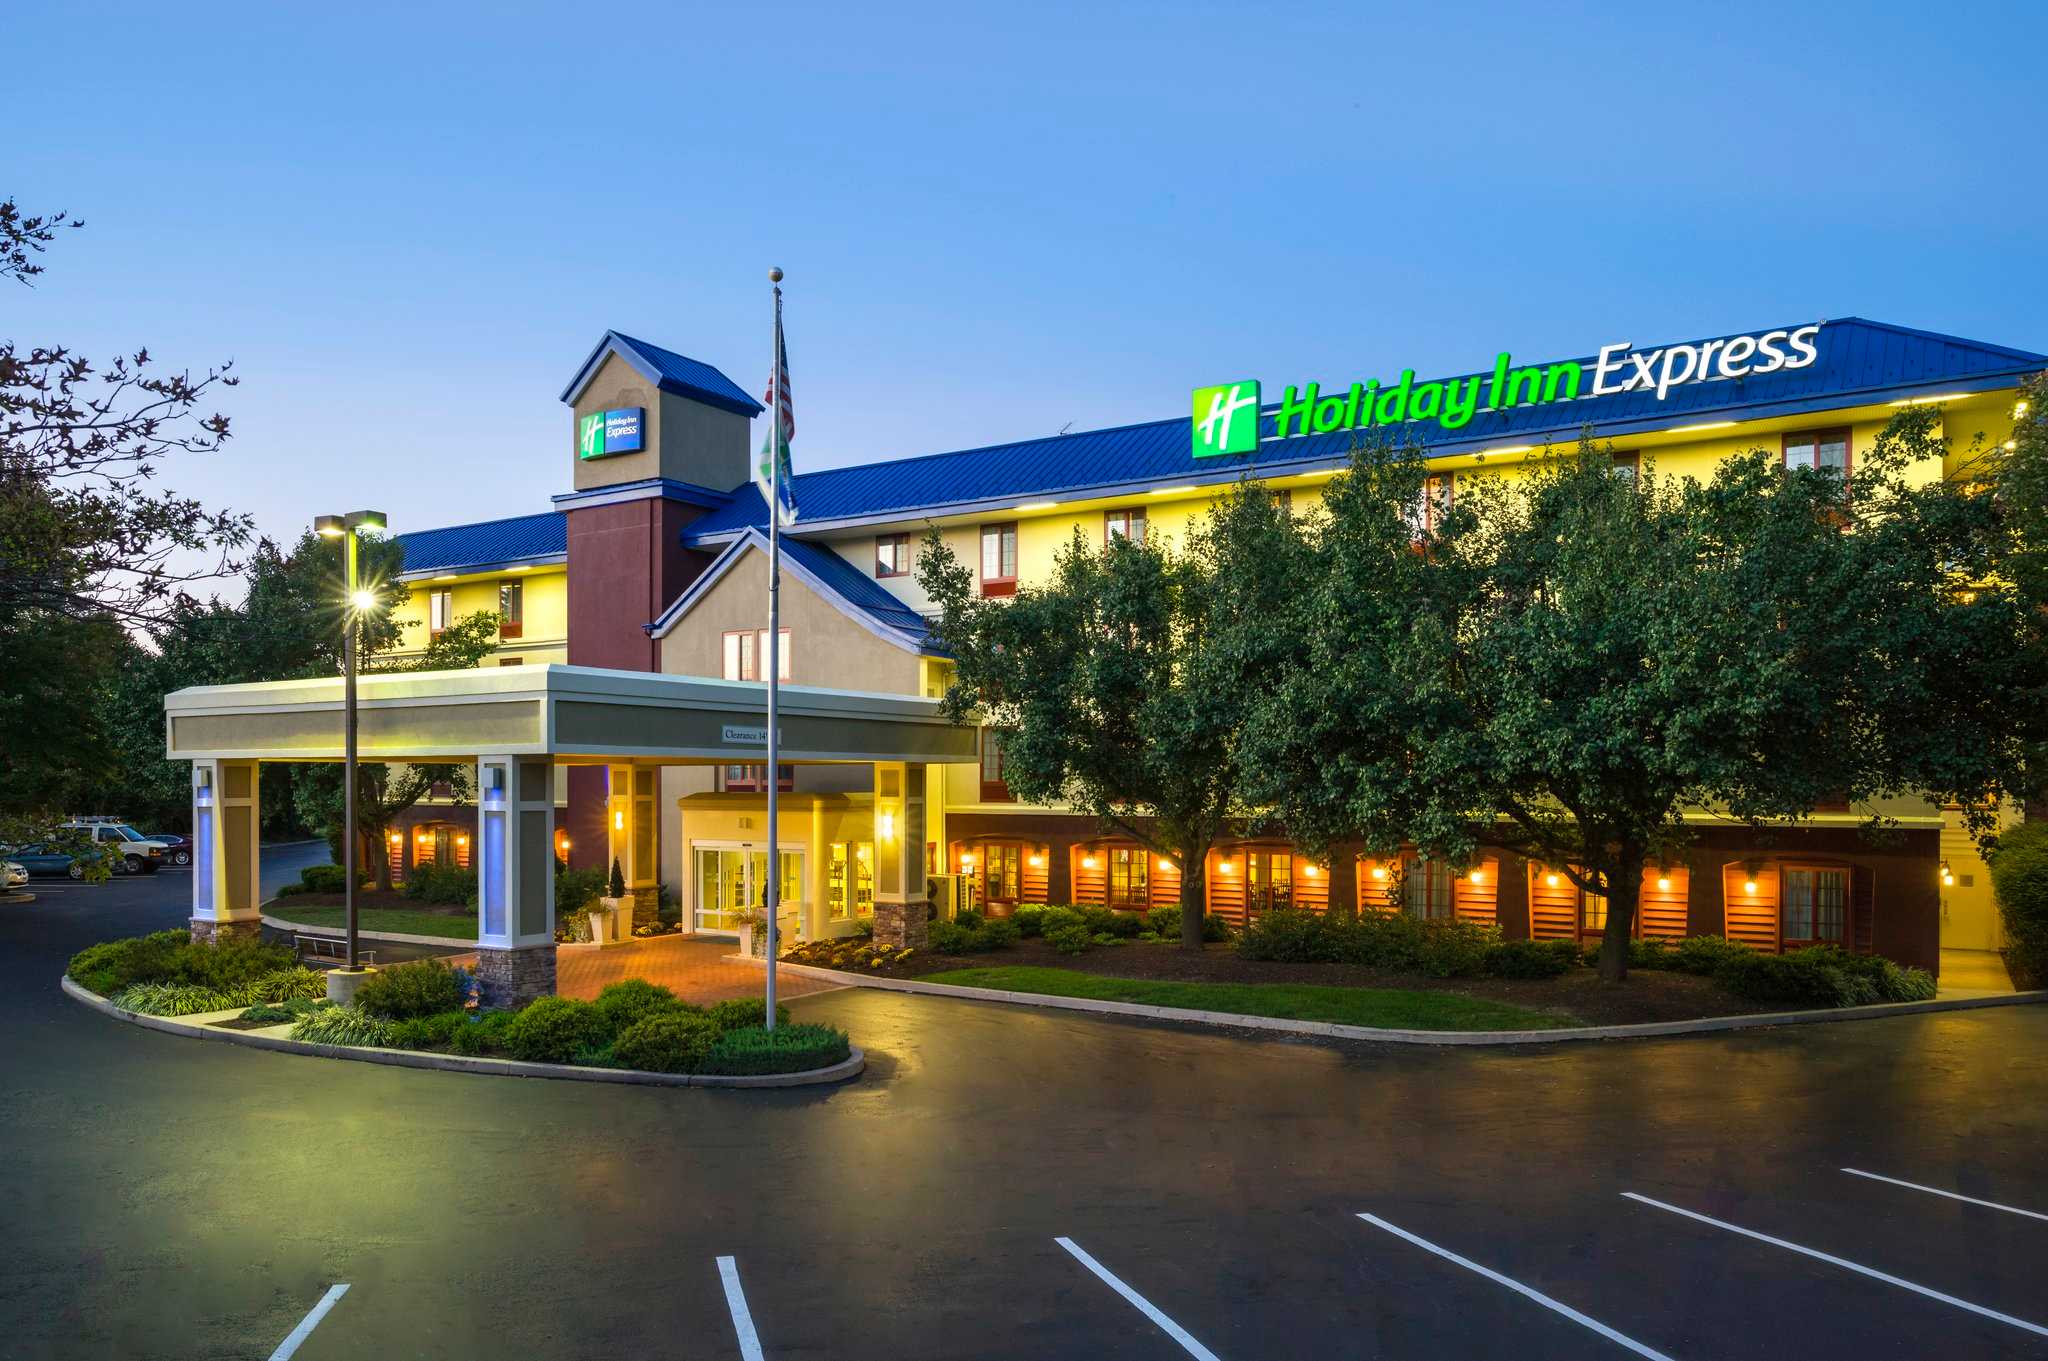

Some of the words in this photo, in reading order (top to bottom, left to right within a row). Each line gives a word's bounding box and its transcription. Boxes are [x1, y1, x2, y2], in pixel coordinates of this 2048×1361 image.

[1275, 370, 1481, 438] Holiday
[1487, 352, 1581, 408] Inn
[1592, 326, 1819, 400] Express
[606, 426, 637, 438] Express
